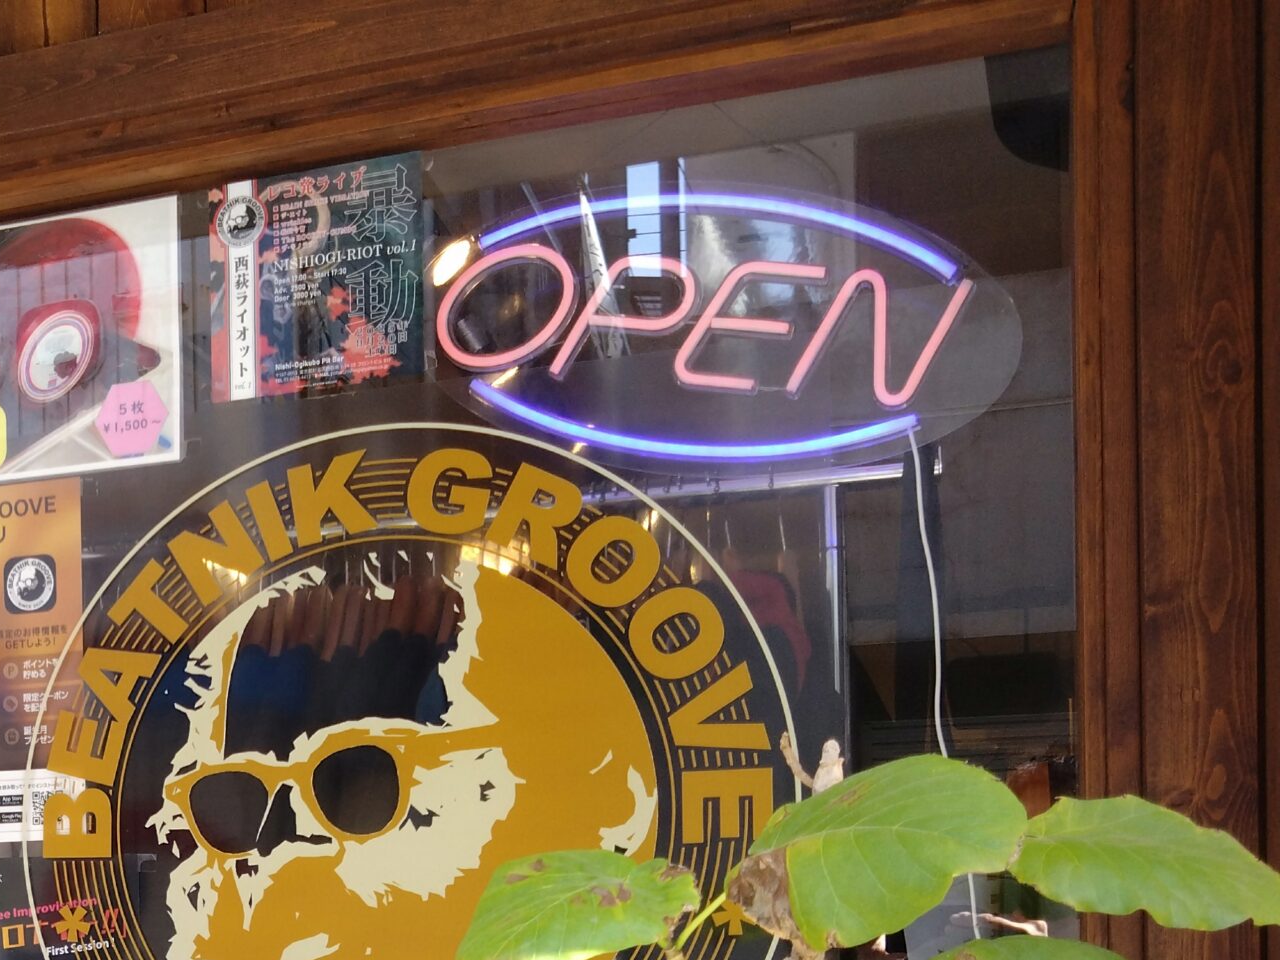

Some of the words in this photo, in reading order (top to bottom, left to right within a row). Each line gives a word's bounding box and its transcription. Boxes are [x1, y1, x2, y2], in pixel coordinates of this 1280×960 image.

[234, 255, 249, 378] 西荻ライオット
[274, 244, 383, 273] NISHIOGI-RIOT
[387, 240, 416, 256] vol.1
[436, 243, 974, 407] OPEN
[42, 448, 377, 858] BEATNIK
[406, 447, 774, 844] GROOVE
[46, 945, 69, 957] First
